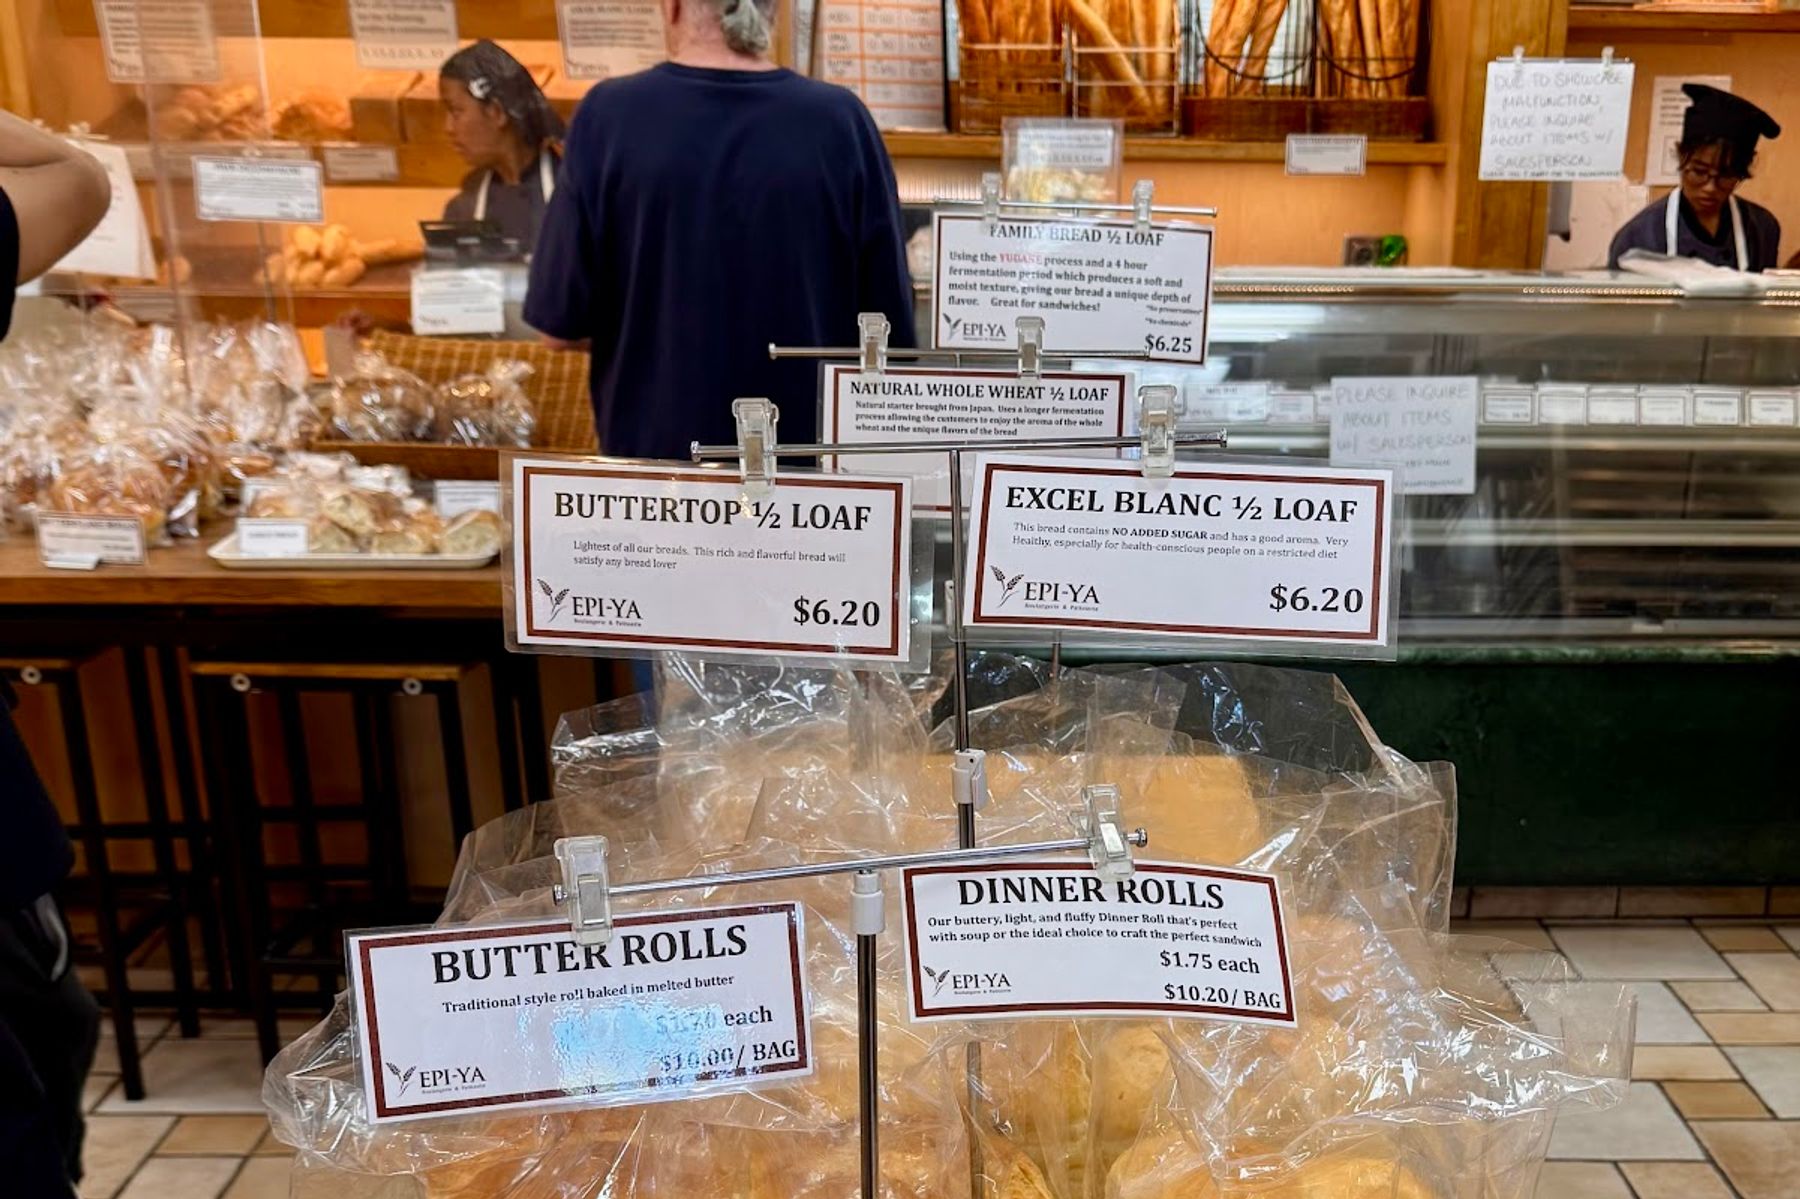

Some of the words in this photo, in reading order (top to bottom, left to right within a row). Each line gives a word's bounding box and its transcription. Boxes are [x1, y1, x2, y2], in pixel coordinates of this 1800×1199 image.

[990, 224, 1044, 238] FAMILY
[1049, 228, 1102, 242] BREAD
[1125, 231, 1164, 246] LOAF
[949, 251, 977, 264] Using
[980, 252, 997, 262] the
[1044, 257, 1083, 269] process
[1084, 257, 1104, 267] and
[1106, 260, 1112, 268] a
[1114, 259, 1121, 268] 4
[1123, 259, 1148, 270] hour
[948, 266, 1016, 277] fermentation
[1018, 270, 1052, 280] period
[1054, 271, 1085, 281] which
[1086, 273, 1134, 284] produces
[1144, 276, 1162, 286] soft
[1164, 278, 1182, 287] and
[948, 281, 976, 290] moist
[980, 282, 1019, 293] texture,
[1020, 285, 1052, 296] giving
[1054, 287, 1072, 295] our
[1074, 286, 1103, 298] bread
[1114, 290, 1148, 301] unique
[1151, 291, 1178, 303] depth
[1181, 294, 1191, 303] of
[948, 295, 978, 305] flavor.
[990, 297, 1018, 307] Great
[1021, 298, 1035, 307] for
[1038, 300, 1100, 311] sandwiches!
[1145, 334, 1192, 353] $6.25
[850, 381, 922, 395] NATURAL
[926, 383, 984, 397] WHOLE
[987, 385, 1045, 398] WHEAT
[1069, 387, 1109, 400] LOAF
[554, 492, 742, 524] BUTTERTOP
[792, 503, 871, 530] LOAF
[1006, 486, 1103, 510] EXCEL
[1113, 490, 1222, 516] BLANC
[1273, 497, 1357, 522] LOAF
[1013, 522, 1034, 531] This
[1037, 523, 1065, 532] bread
[1067, 526, 1110, 534] contains
[1112, 527, 1128, 535] NO
[1129, 528, 1169, 537] ADDED
[1170, 529, 1208, 539] SUGAR
[1209, 531, 1228, 540] and
[1230, 532, 1248, 541] has
[1258, 534, 1284, 543] good
[1325, 536, 1348, 546] Very
[573, 540, 609, 554] Lightest
[612, 542, 621, 551] of
[623, 542, 634, 552] all
[656, 544, 688, 554] breads.
[695, 546, 713, 556] This
[716, 547, 733, 556] rich
[738, 548, 753, 558] and
[757, 548, 794, 560] flavorful
[799, 551, 825, 561] bread
[828, 553, 844, 562] will
[1012, 535, 1051, 547] Healthy,
[1054, 539, 1102, 550] especially
[1104, 539, 1119, 549] for
[1121, 541, 1204, 553] health-conscious
[1207, 545, 1240, 556] people
[1243, 548, 1255, 557] on
[1266, 548, 1315, 559] restricted
[1317, 549, 1337, 558] diet
[573, 556, 604, 567] satisfy
[605, 558, 622, 568] any
[624, 556, 651, 567] bread
[652, 558, 677, 568] lover
[1024, 582, 1100, 605] EPI-YA
[1269, 584, 1364, 613] $6.20
[572, 596, 642, 620] EPI-YA
[793, 595, 881, 627] $6.20
[958, 877, 1107, 906] DINNER
[1116, 879, 1225, 910] ROLLS
[928, 917, 951, 926] Our
[954, 915, 1002, 925] buttery,
[1004, 912, 1035, 924] light,
[1038, 912, 1060, 922] and
[1064, 911, 1095, 923] fluffy
[1098, 912, 1139, 922] Dinner
[1142, 914, 1164, 923] Roll
[1166, 914, 1197, 926] that's
[1200, 919, 1237, 929] perfect
[929, 931, 957, 941] with
[960, 932, 990, 942] soup
[1010, 928, 1029, 937] the
[1032, 927, 1062, 937] ideal
[1065, 927, 1102, 936] choice
[1106, 929, 1117, 937] to
[1120, 928, 1147, 937] craft
[1150, 929, 1168, 938] the
[1171, 931, 1209, 942] perfect
[1212, 935, 1261, 946] sandwich
[432, 941, 611, 984] BUTTER
[622, 924, 748, 966] ROLLS
[1159, 950, 1213, 970] $1.75
[1218, 956, 1259, 974] each
[952, 973, 1011, 990] EPI-YA
[442, 994, 520, 1012] Traditional
[524, 992, 556, 1006] style
[560, 988, 583, 1003] roll
[586, 984, 627, 998] baked
[631, 984, 643, 994] in
[647, 977, 691, 992] melted
[694, 976, 734, 987] butter
[1245, 989, 1281, 1009] BAG
[724, 1005, 773, 1027] each
[753, 1040, 797, 1061] BAG
[420, 1066, 486, 1089] EPI-YA
